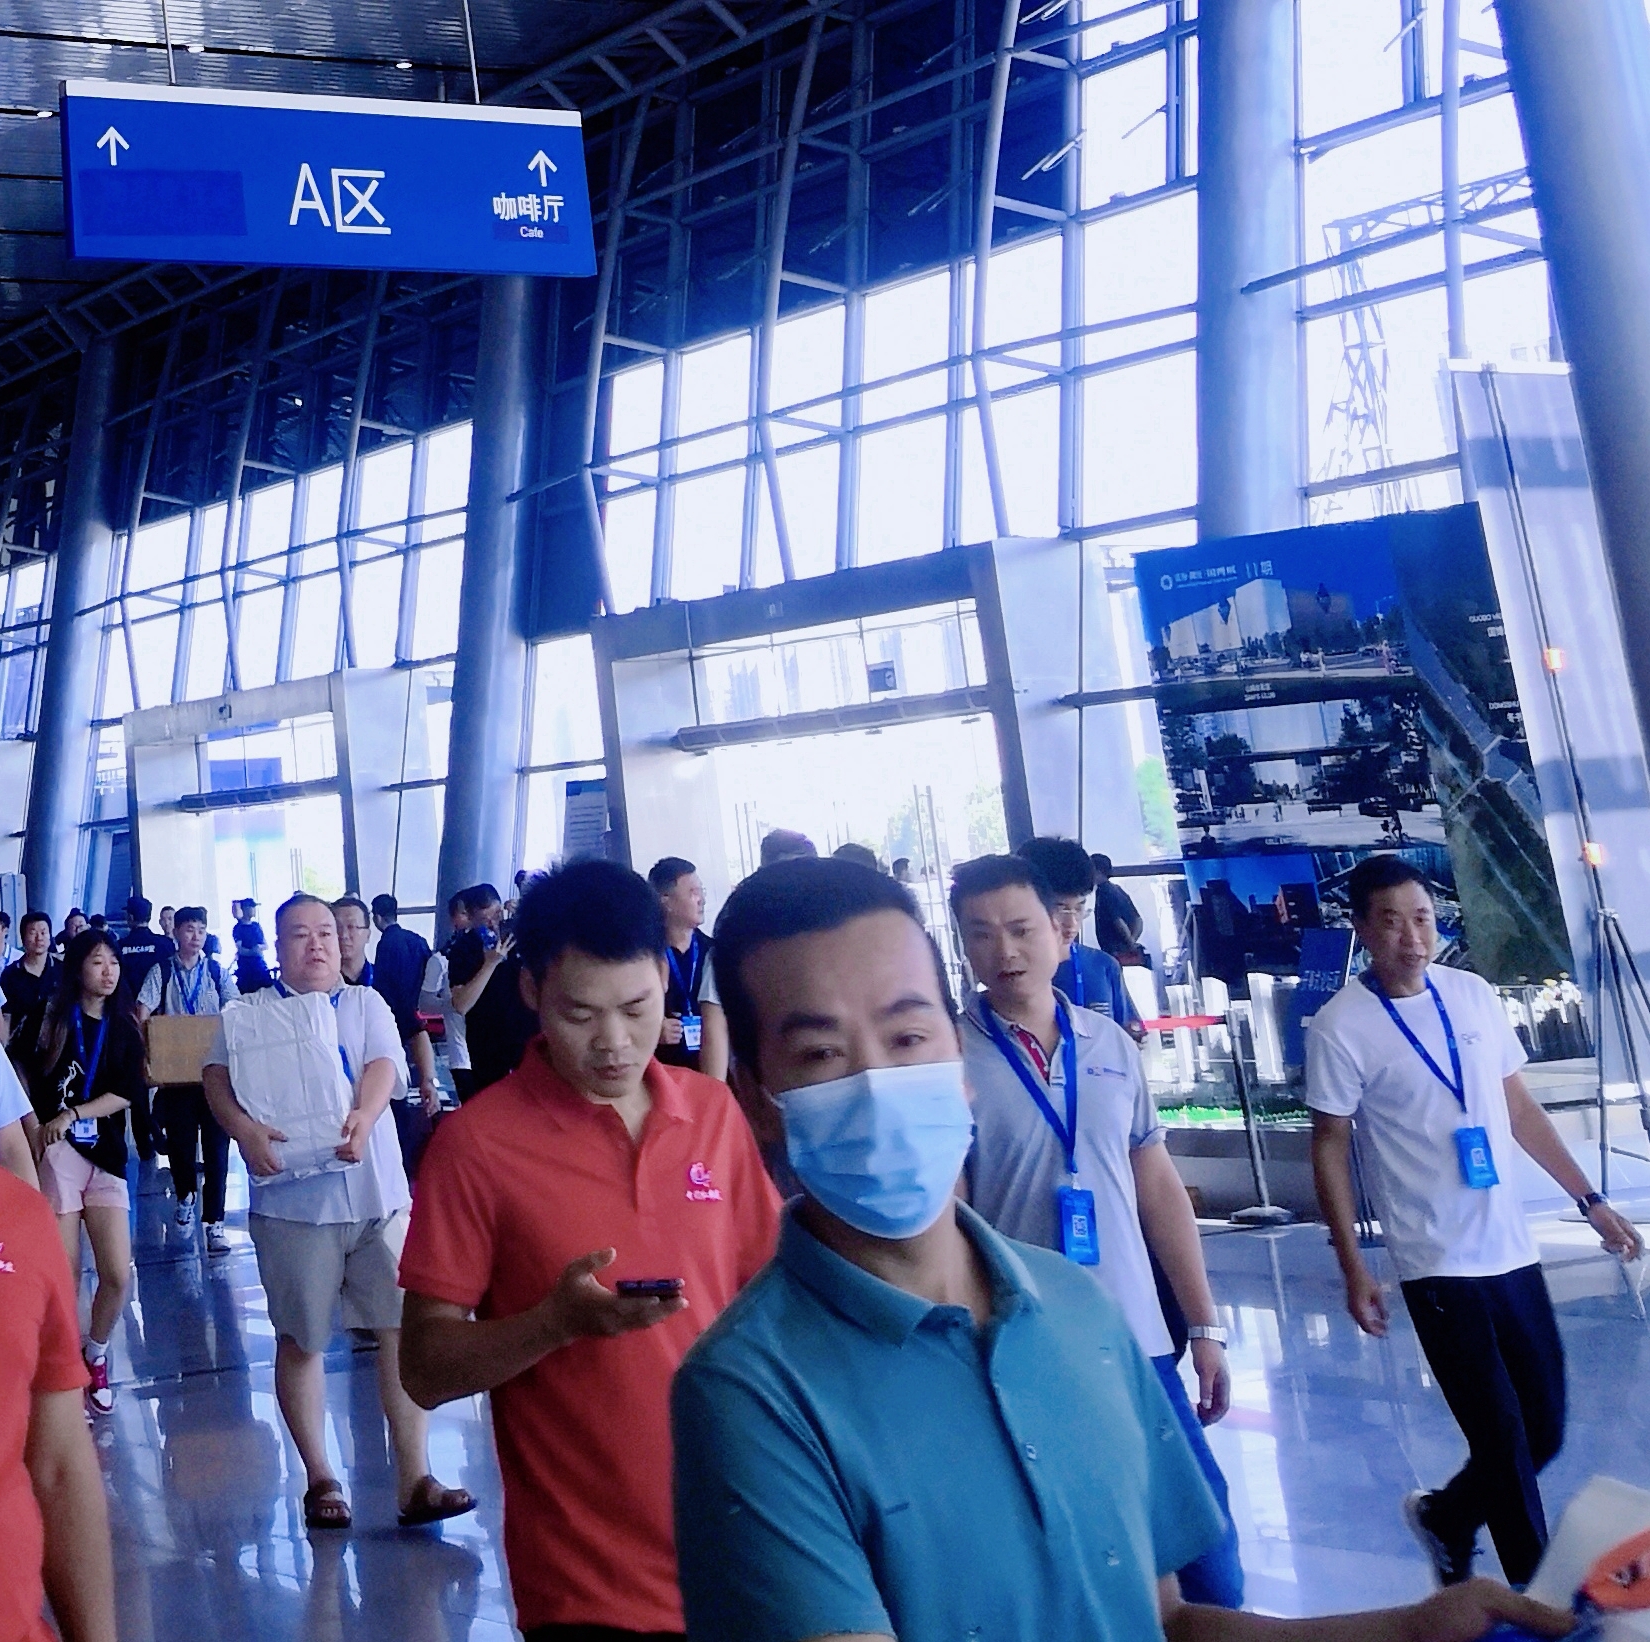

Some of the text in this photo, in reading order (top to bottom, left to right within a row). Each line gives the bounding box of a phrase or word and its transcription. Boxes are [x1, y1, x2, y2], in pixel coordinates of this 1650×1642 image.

[289, 162, 392, 235] A区
[492, 191, 565, 223] 咖啡厅
